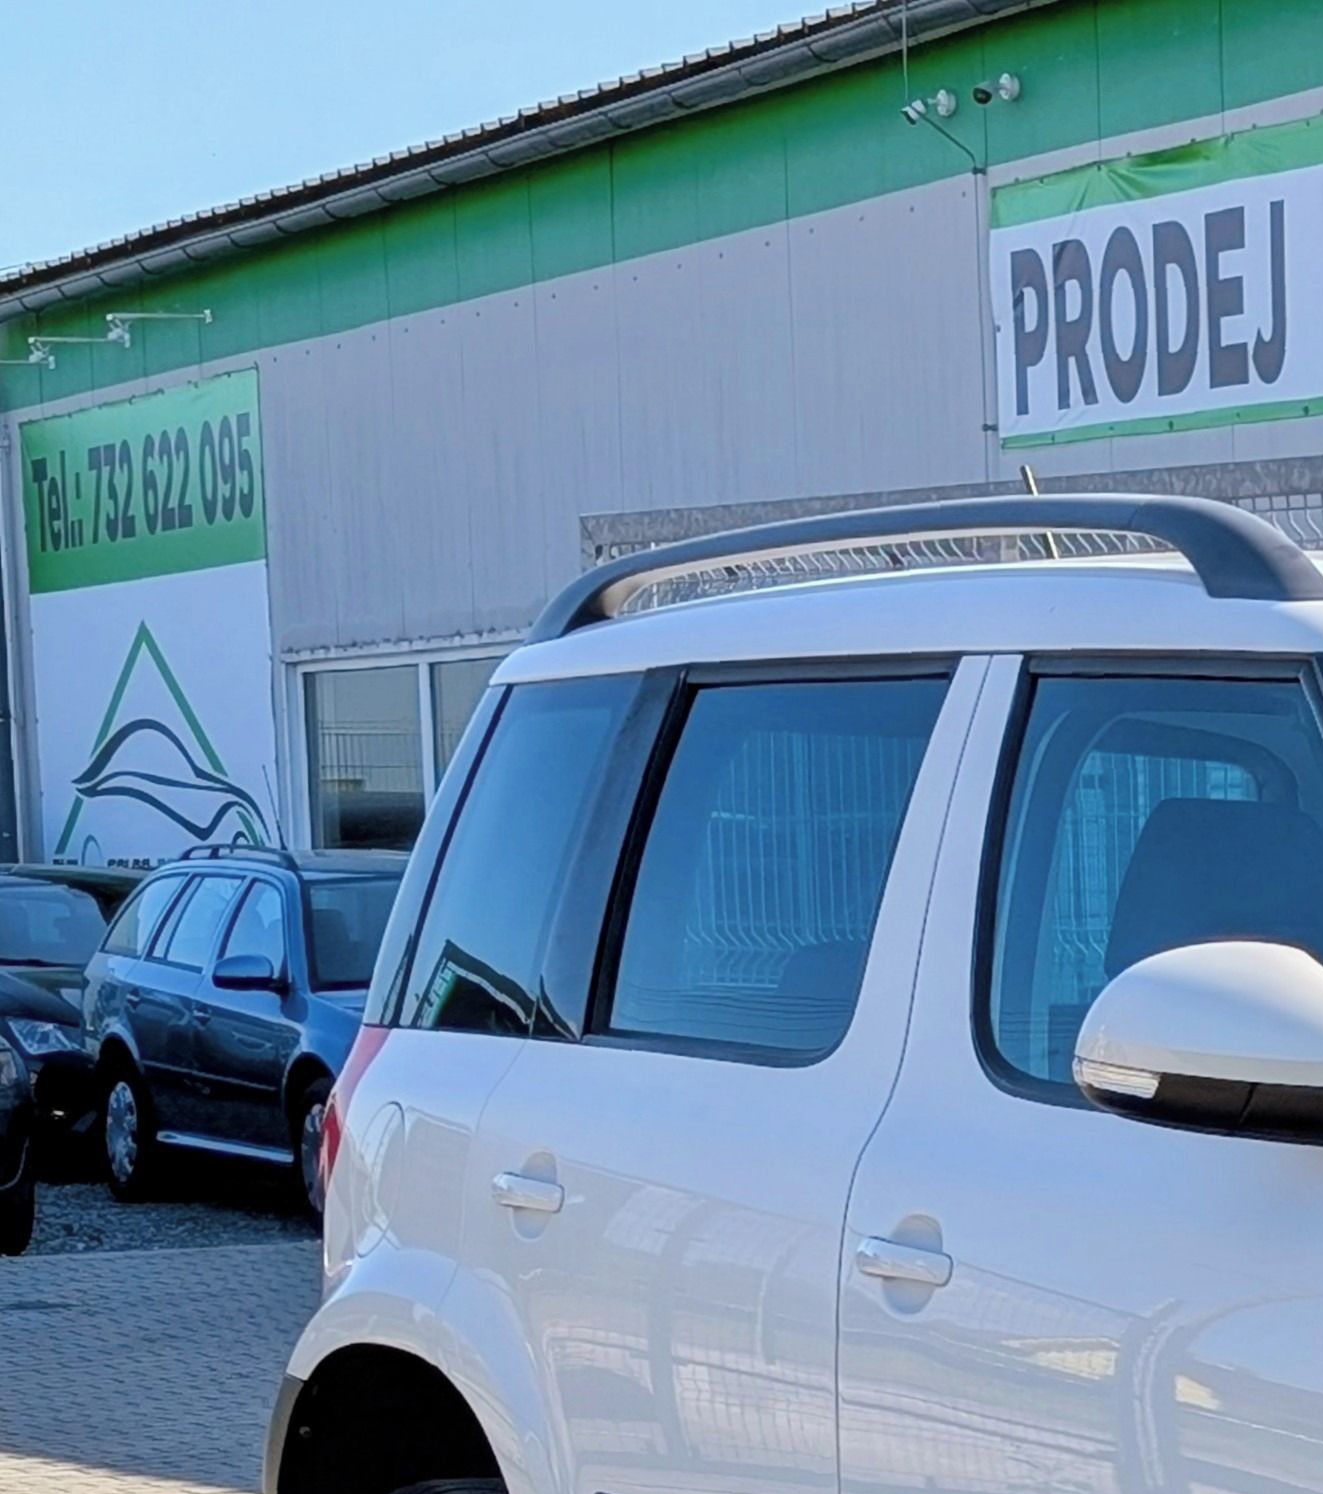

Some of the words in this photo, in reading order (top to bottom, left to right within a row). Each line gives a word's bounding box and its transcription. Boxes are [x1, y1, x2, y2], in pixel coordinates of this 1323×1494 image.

[1011, 200, 1287, 416] PRODEJ
[31, 450, 84, 552] Tel.:
[88, 439, 136, 544] 732
[142, 426, 193, 535] 622
[200, 412, 254, 525] 095
